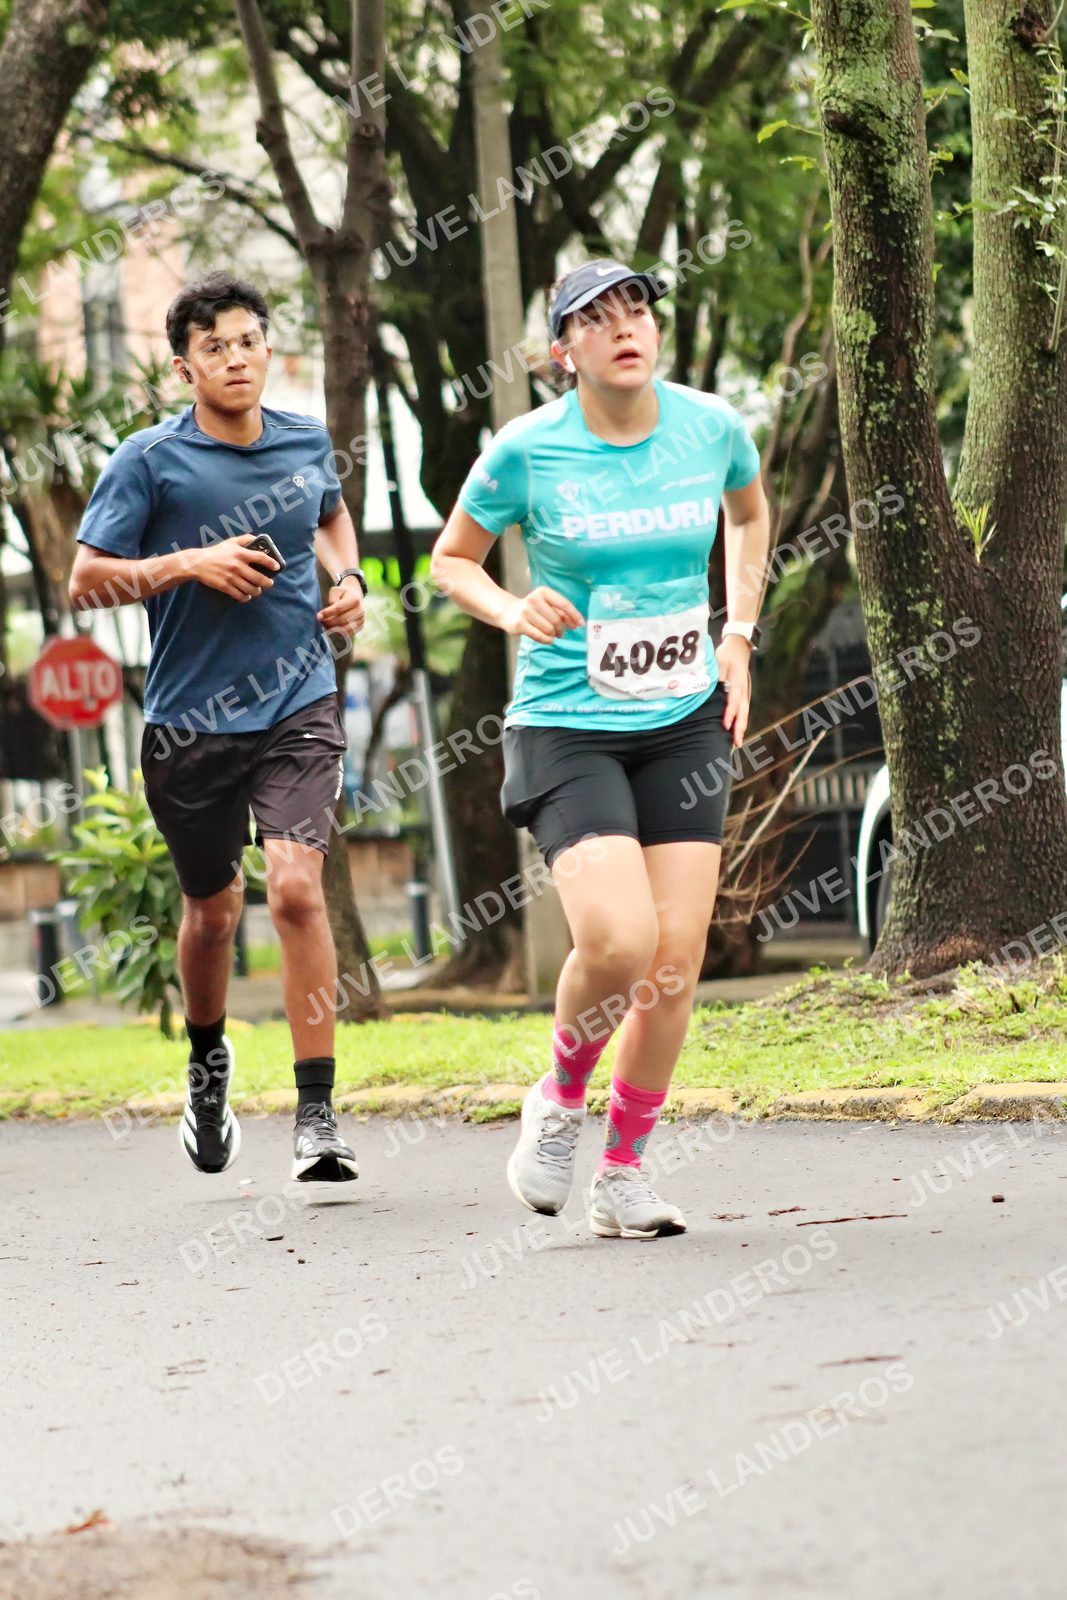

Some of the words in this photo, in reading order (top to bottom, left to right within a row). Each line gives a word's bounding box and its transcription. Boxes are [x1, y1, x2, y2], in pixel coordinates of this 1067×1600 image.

[561, 497, 718, 541] PERDURA
[600, 630, 699, 677] 4068
[42, 661, 117, 701] ALTO
